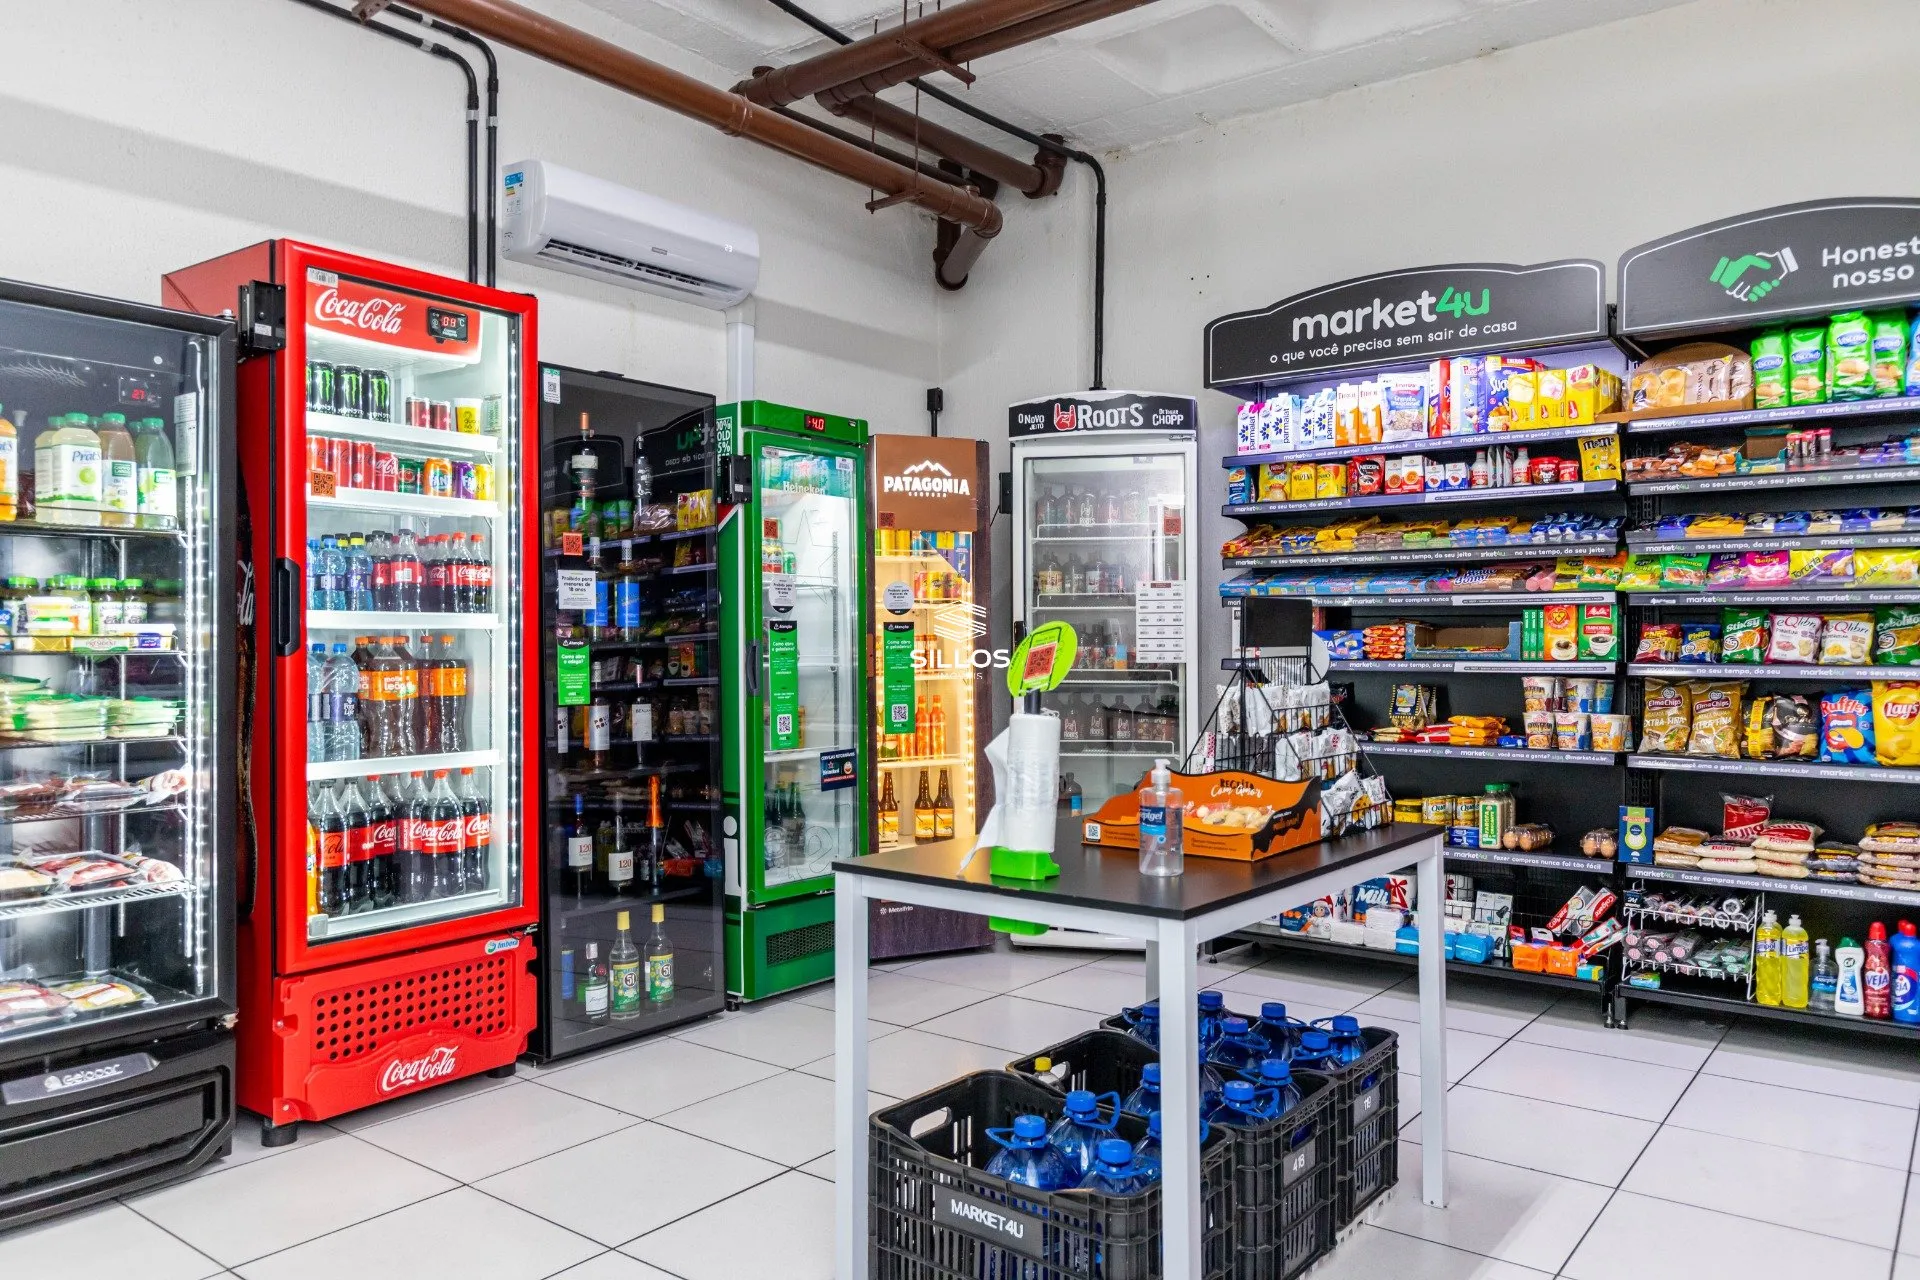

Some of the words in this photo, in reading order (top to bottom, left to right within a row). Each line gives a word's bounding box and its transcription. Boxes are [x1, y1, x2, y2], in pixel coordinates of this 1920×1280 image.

[1822, 235, 1920, 267] Honest
[1833, 265, 1914, 288] nosso
[315, 288, 406, 334] Coca-Cola
[1293, 287, 1490, 342] market4u
[1270, 354, 1278, 364] o
[1282, 351, 1305, 364] que
[1309, 343, 1339, 358] você
[1344, 338, 1392, 356] precisa
[1397, 334, 1422, 346] sem
[1428, 325, 1453, 341] sair
[1459, 324, 1477, 338] de
[1483, 320, 1517, 334] casa
[1018, 413, 1023, 424] O
[1024, 414, 1044, 424] NOVO
[1078, 403, 1143, 428] ROOTS
[1152, 414, 1184, 426] CHOPP
[1531, 431, 1550, 439] gente?
[783, 481, 825, 496] Heineken
[883, 476, 970, 496] PATAGONIA
[1650, 483, 1690, 491] market4u
[1727, 479, 1755, 488] tempo,
[1786, 476, 1806, 485] jeito
[1645, 544, 1685, 552] market4u
[1723, 541, 1751, 551] tempo,
[1782, 539, 1800, 548] jeito
[1821, 536, 1865, 545] market4u
[1457, 551, 1472, 559] jeito
[1538, 548, 1560, 556] tempo,
[1588, 546, 1605, 555] jeito
[1686, 595, 1727, 603] market4u
[1733, 595, 1754, 603] fazer
[1756, 595, 1789, 603] compras
[1816, 594, 1861, 602] market4u
[1869, 593, 1891, 601] fazer
[1350, 661, 1380, 669] market4u
[1723, 667, 1752, 676] tempo,
[1821, 695, 1868, 716] Ruffles
[1460, 749, 1494, 757] market4u
[1720, 763, 1743, 772] gente?
[1760, 765, 1809, 775] @market4u.br
[619, 859, 632, 868] 120
[1454, 851, 1488, 860] market4u
[1512, 857, 1539, 865] compras
[1586, 862, 1601, 870] fácil
[1635, 869, 1675, 879] market4u
[1681, 873, 1701, 881] fazer
[1703, 876, 1735, 885] compras
[1736, 879, 1760, 887] nunca
[1762, 880, 1773, 888] foi
[1774, 881, 1788, 890] tão
[1790, 882, 1808, 892] fácil
[1355, 887, 1389, 906] Mili
[1874, 892, 1897, 901] fazer
[1594, 895, 1615, 917] Colgate
[663, 966, 671, 976] 51
[626, 974, 635, 986] 51
[1866, 974, 1889, 985] VEJA
[382, 1046, 459, 1091] Coca-Cola
[951, 1198, 1024, 1239] MARKET4U
